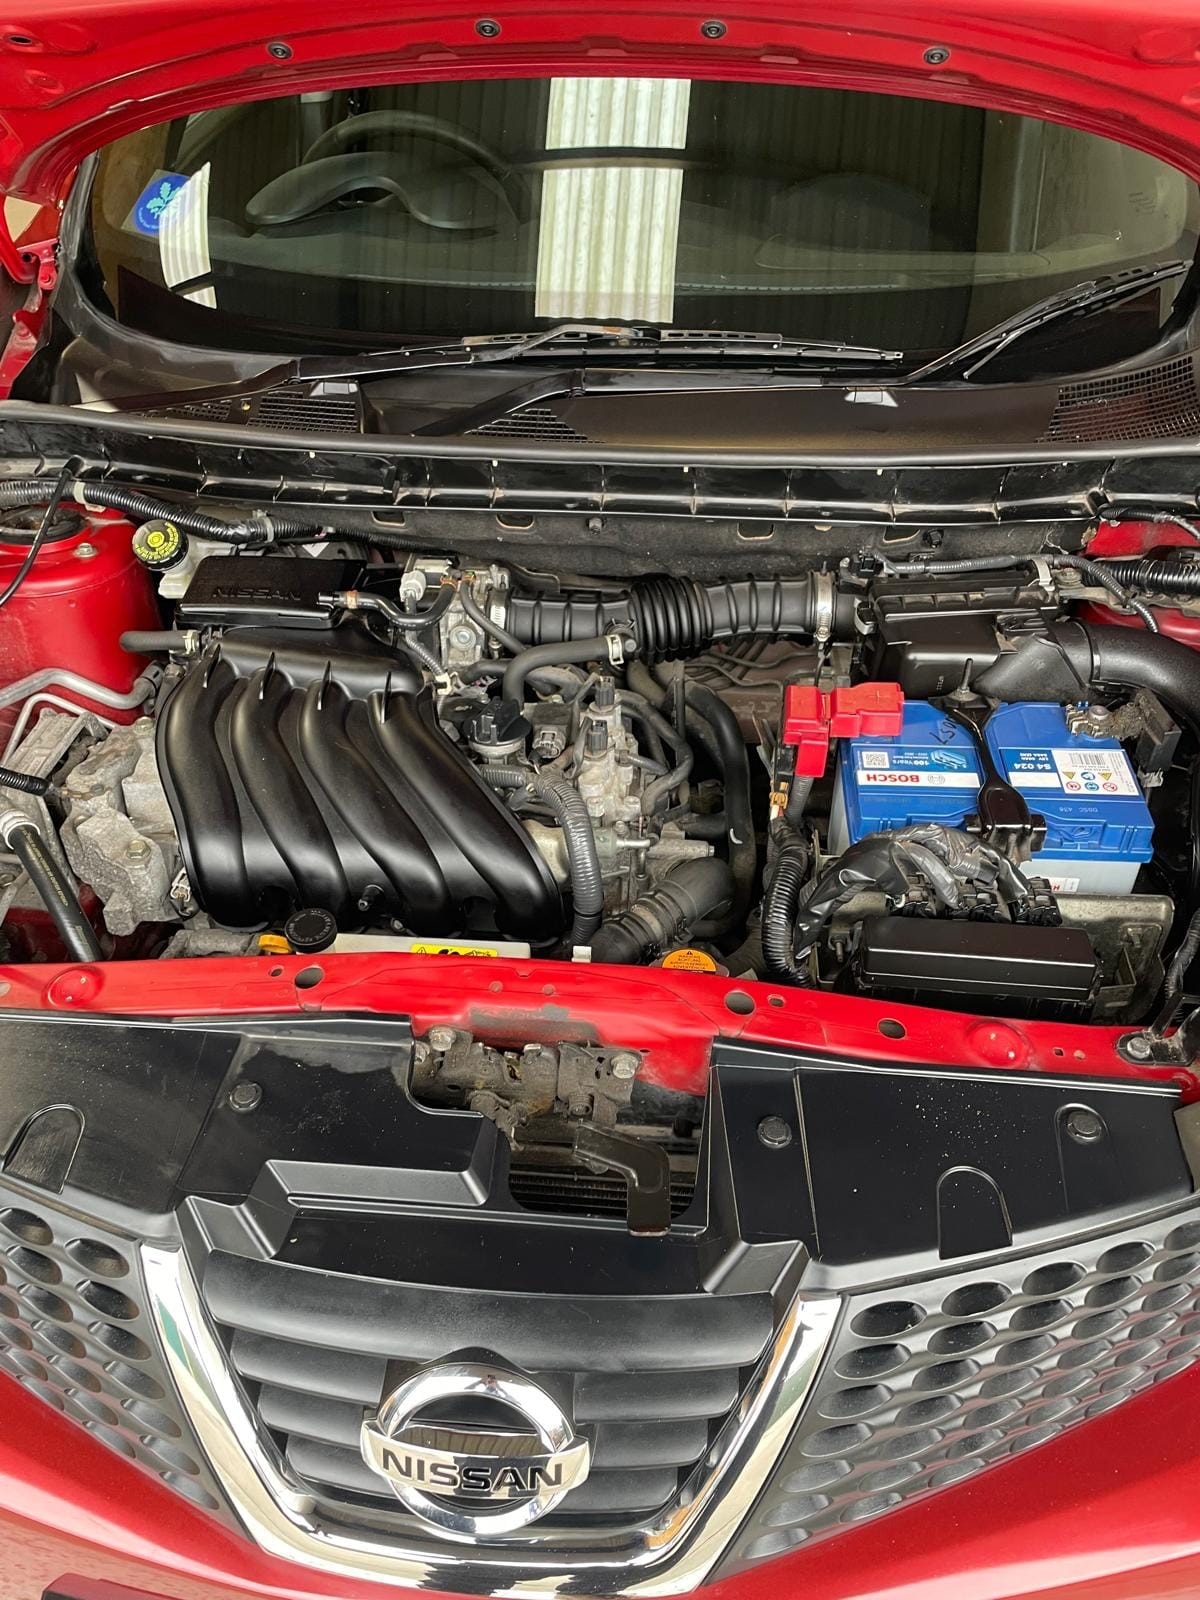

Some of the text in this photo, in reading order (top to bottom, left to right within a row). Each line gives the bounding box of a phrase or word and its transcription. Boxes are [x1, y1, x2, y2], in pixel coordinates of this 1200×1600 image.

[212, 587, 301, 601] NISSAN
[866, 774, 920, 783] BOSCH
[382, 1448, 563, 1492] NISSAN
